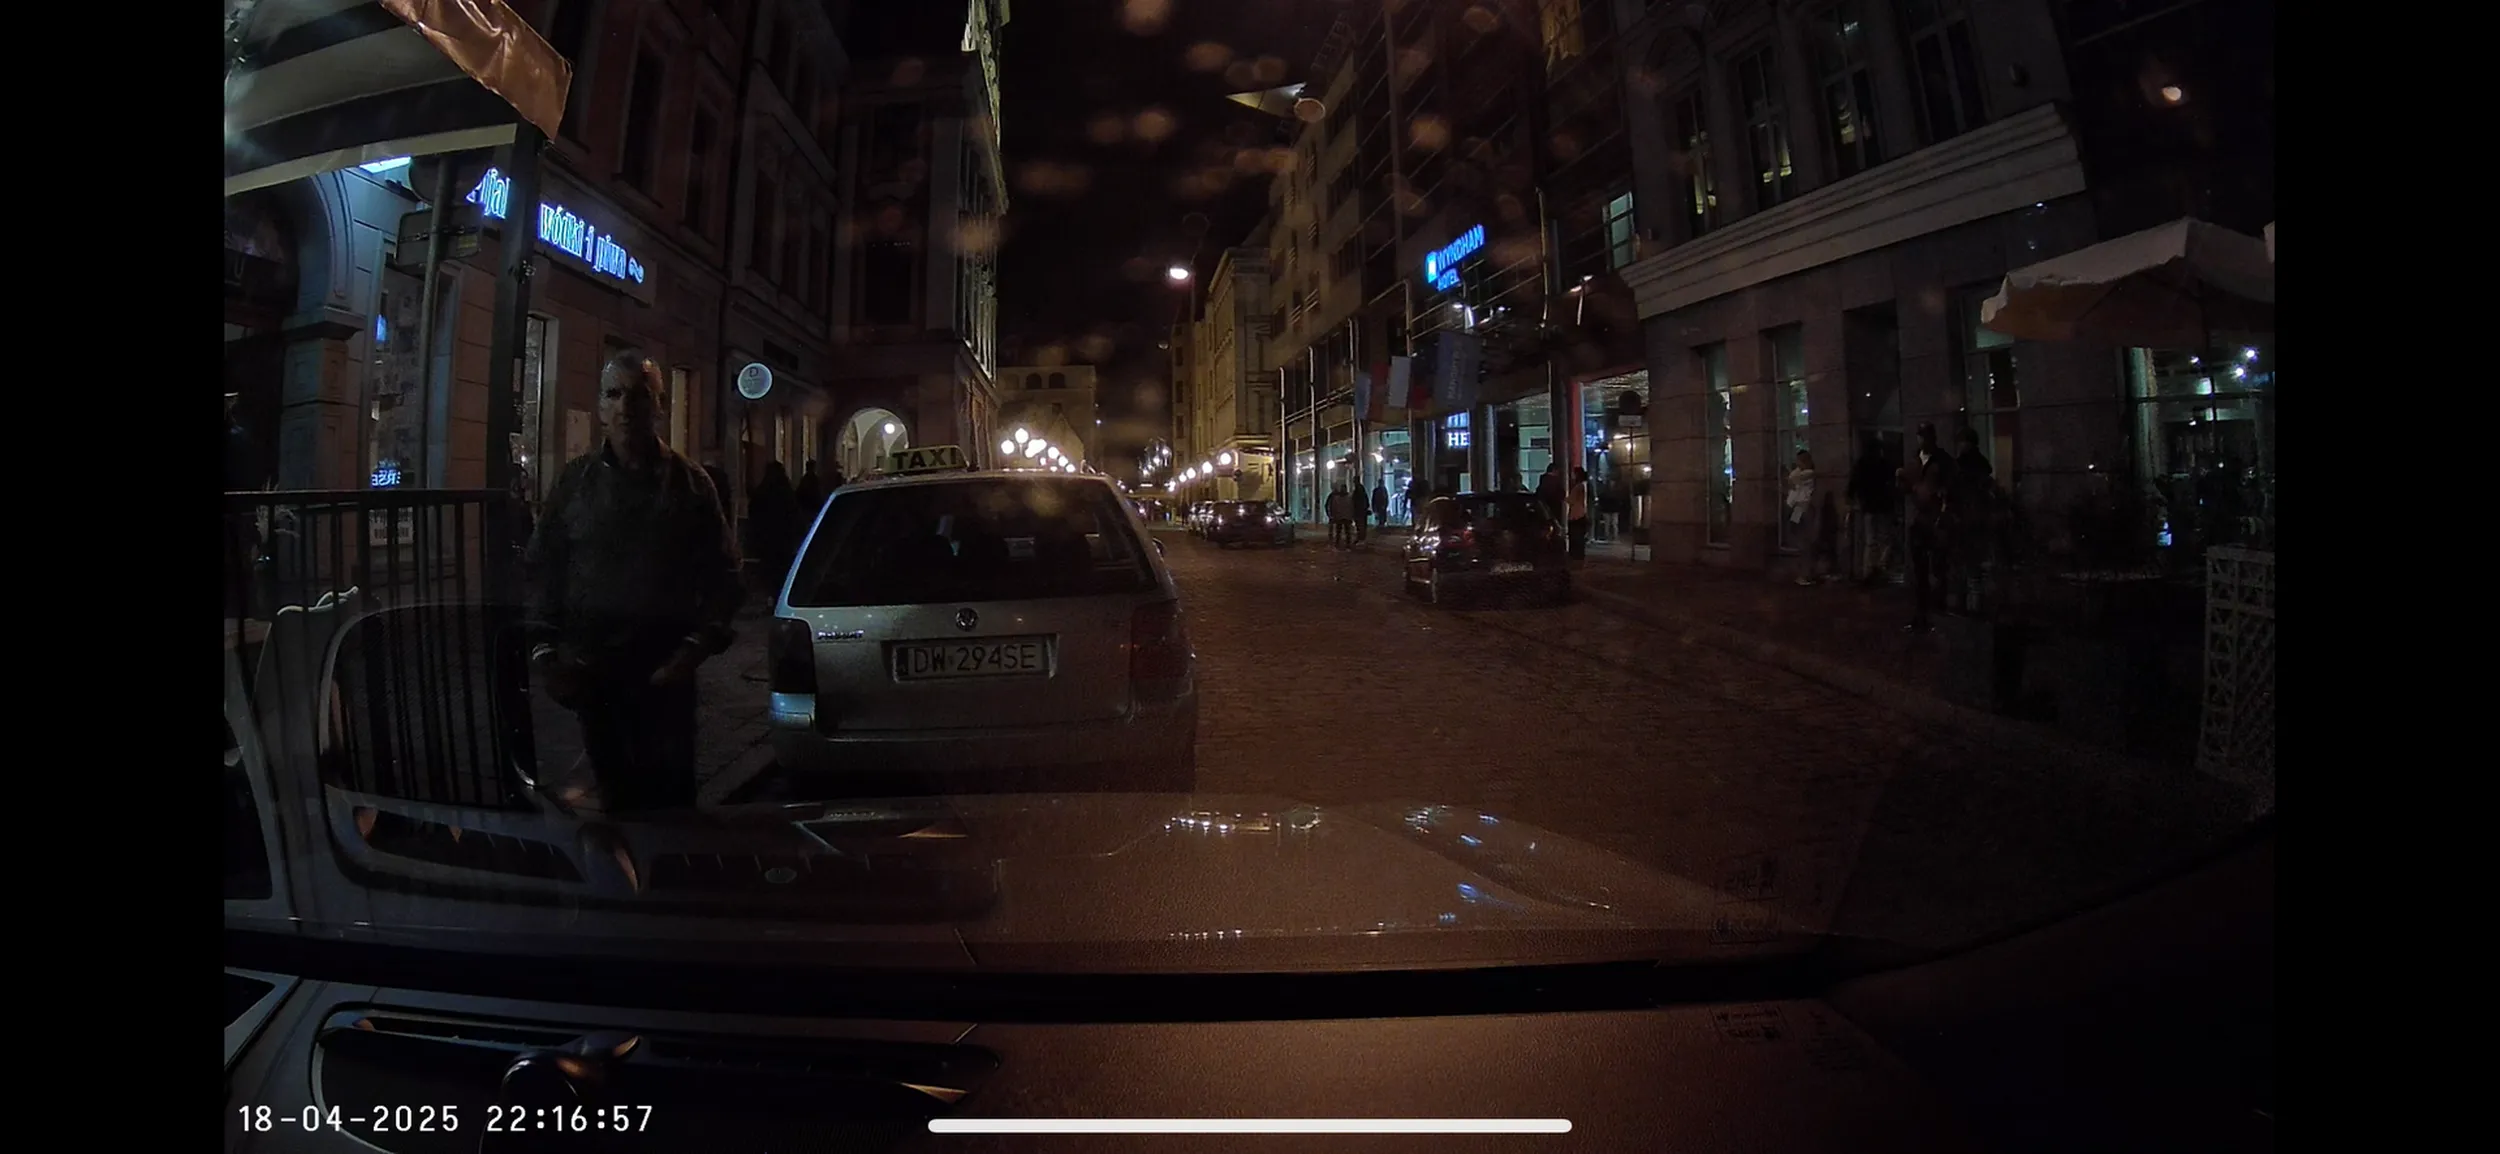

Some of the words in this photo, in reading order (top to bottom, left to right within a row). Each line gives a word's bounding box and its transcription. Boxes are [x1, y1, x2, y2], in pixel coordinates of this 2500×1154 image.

[540, 203, 584, 257] wódki
[585, 225, 595, 262] i
[593, 234, 627, 279] piwa
[1437, 223, 1484, 271] WYNDHAM
[1437, 268, 1460, 291] HOTEL
[892, 447, 957, 470] TAXI
[914, 647, 946, 673] DW
[956, 644, 1036, 671] 294SE
